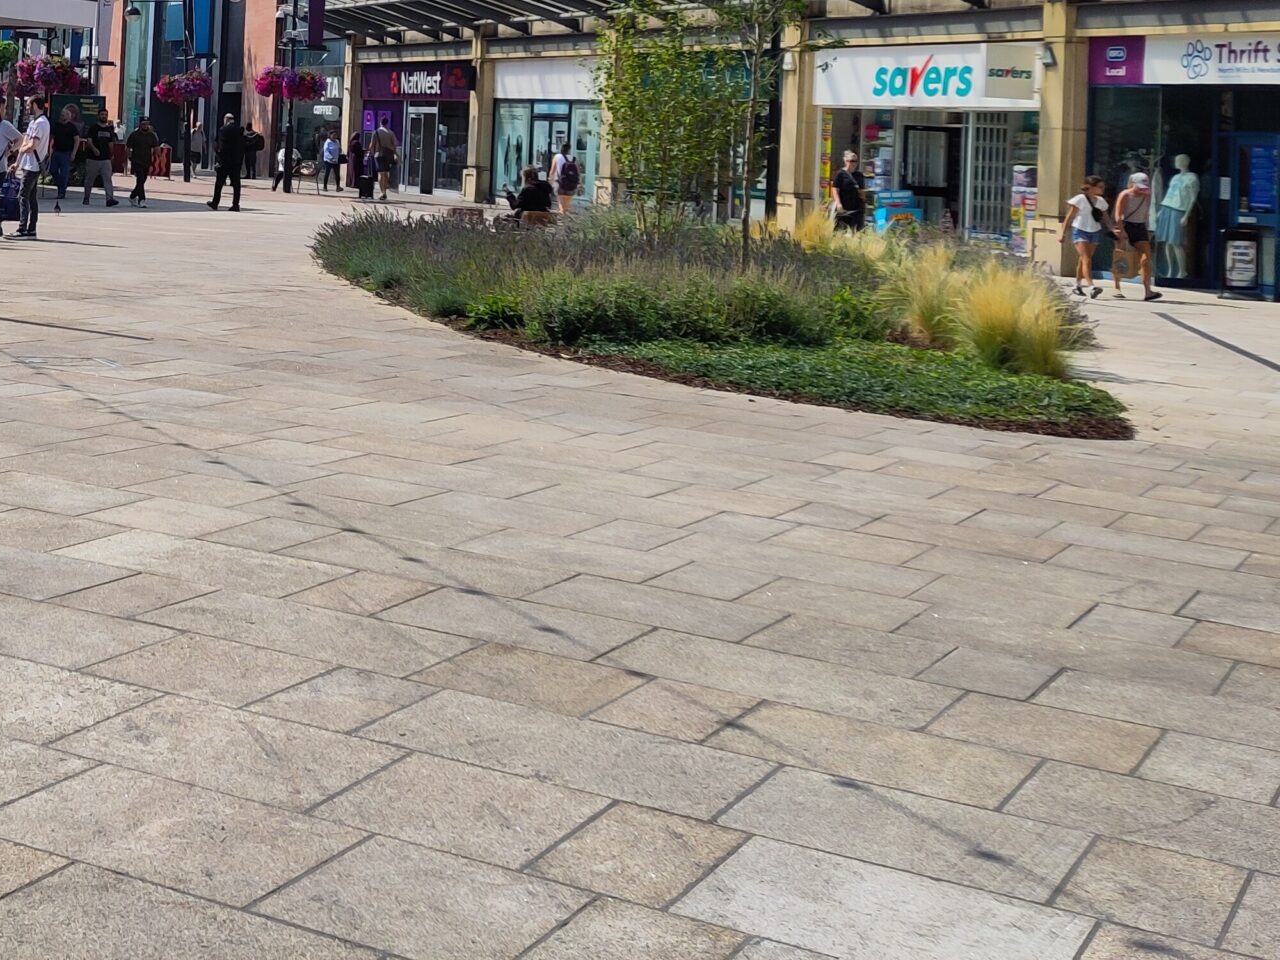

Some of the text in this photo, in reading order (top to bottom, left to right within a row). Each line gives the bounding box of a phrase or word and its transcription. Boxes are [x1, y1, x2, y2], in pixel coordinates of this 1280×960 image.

[1214, 40, 1270, 63] Thrift
[400, 71, 441, 94] NatWest
[872, 54, 974, 97] savers
[987, 66, 1033, 80] savers
